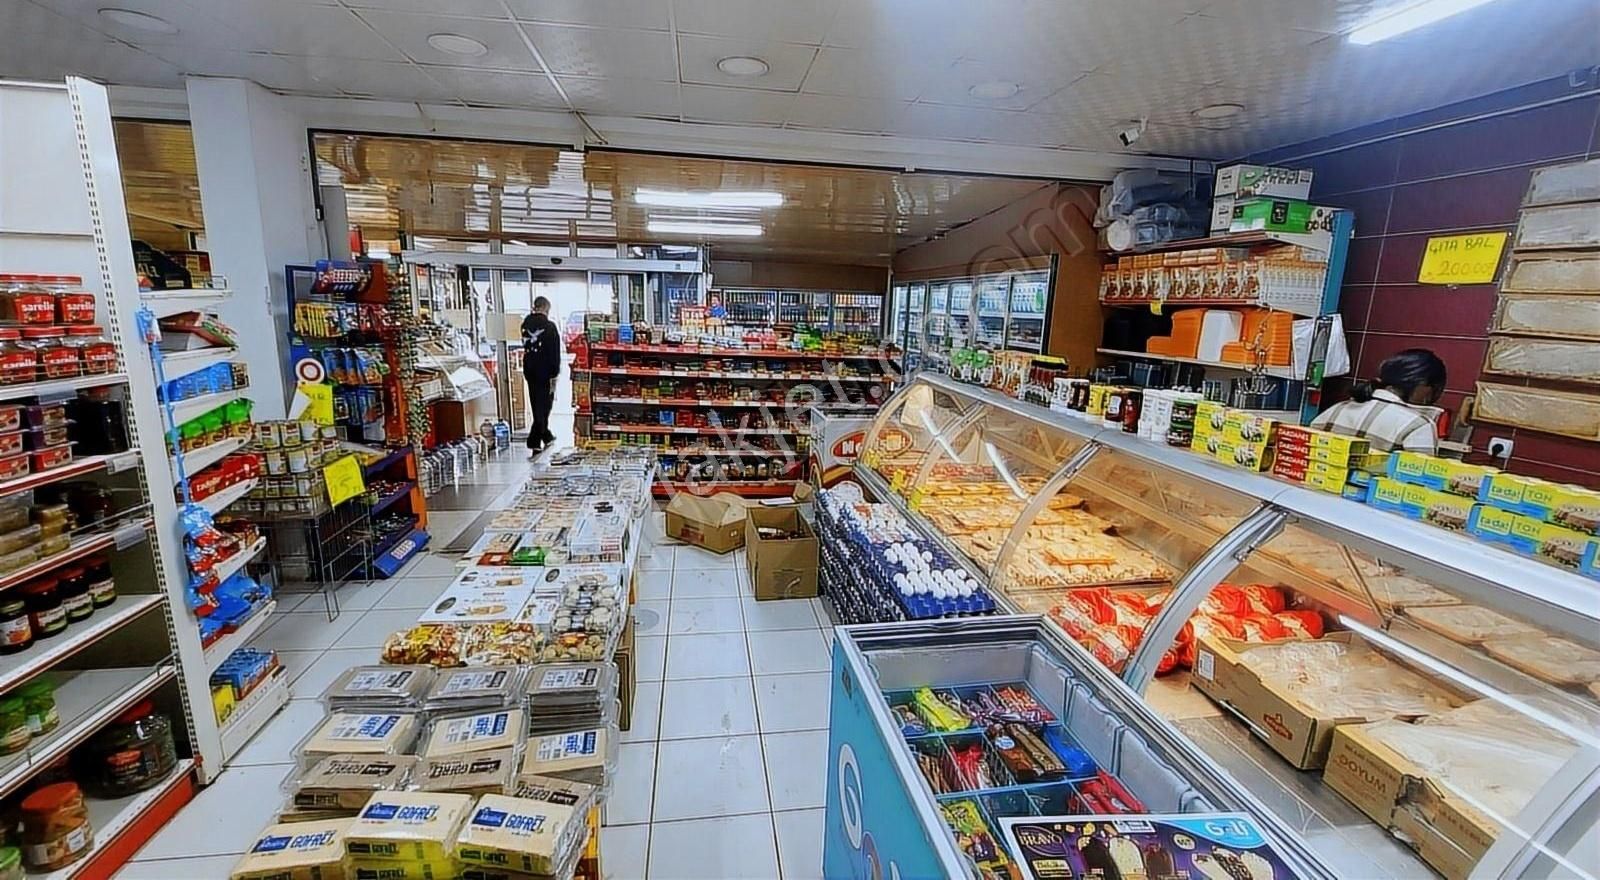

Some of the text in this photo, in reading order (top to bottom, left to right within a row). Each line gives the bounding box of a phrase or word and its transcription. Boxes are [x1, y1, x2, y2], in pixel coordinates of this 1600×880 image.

[1464, 237, 1495, 250] BAL
[22, 301, 54, 311] sarelle
[67, 301, 95, 311] sarelle
[1429, 464, 1448, 473] TON
[1407, 492, 1426, 501] TON
[1528, 490, 1552, 501] TON
[1516, 522, 1540, 533] TON
[397, 804, 440, 820] GOFRET
[505, 813, 546, 832] GOFRET
[290, 829, 337, 848] GOFRET
[1021, 833, 1062, 847] BRAVO
